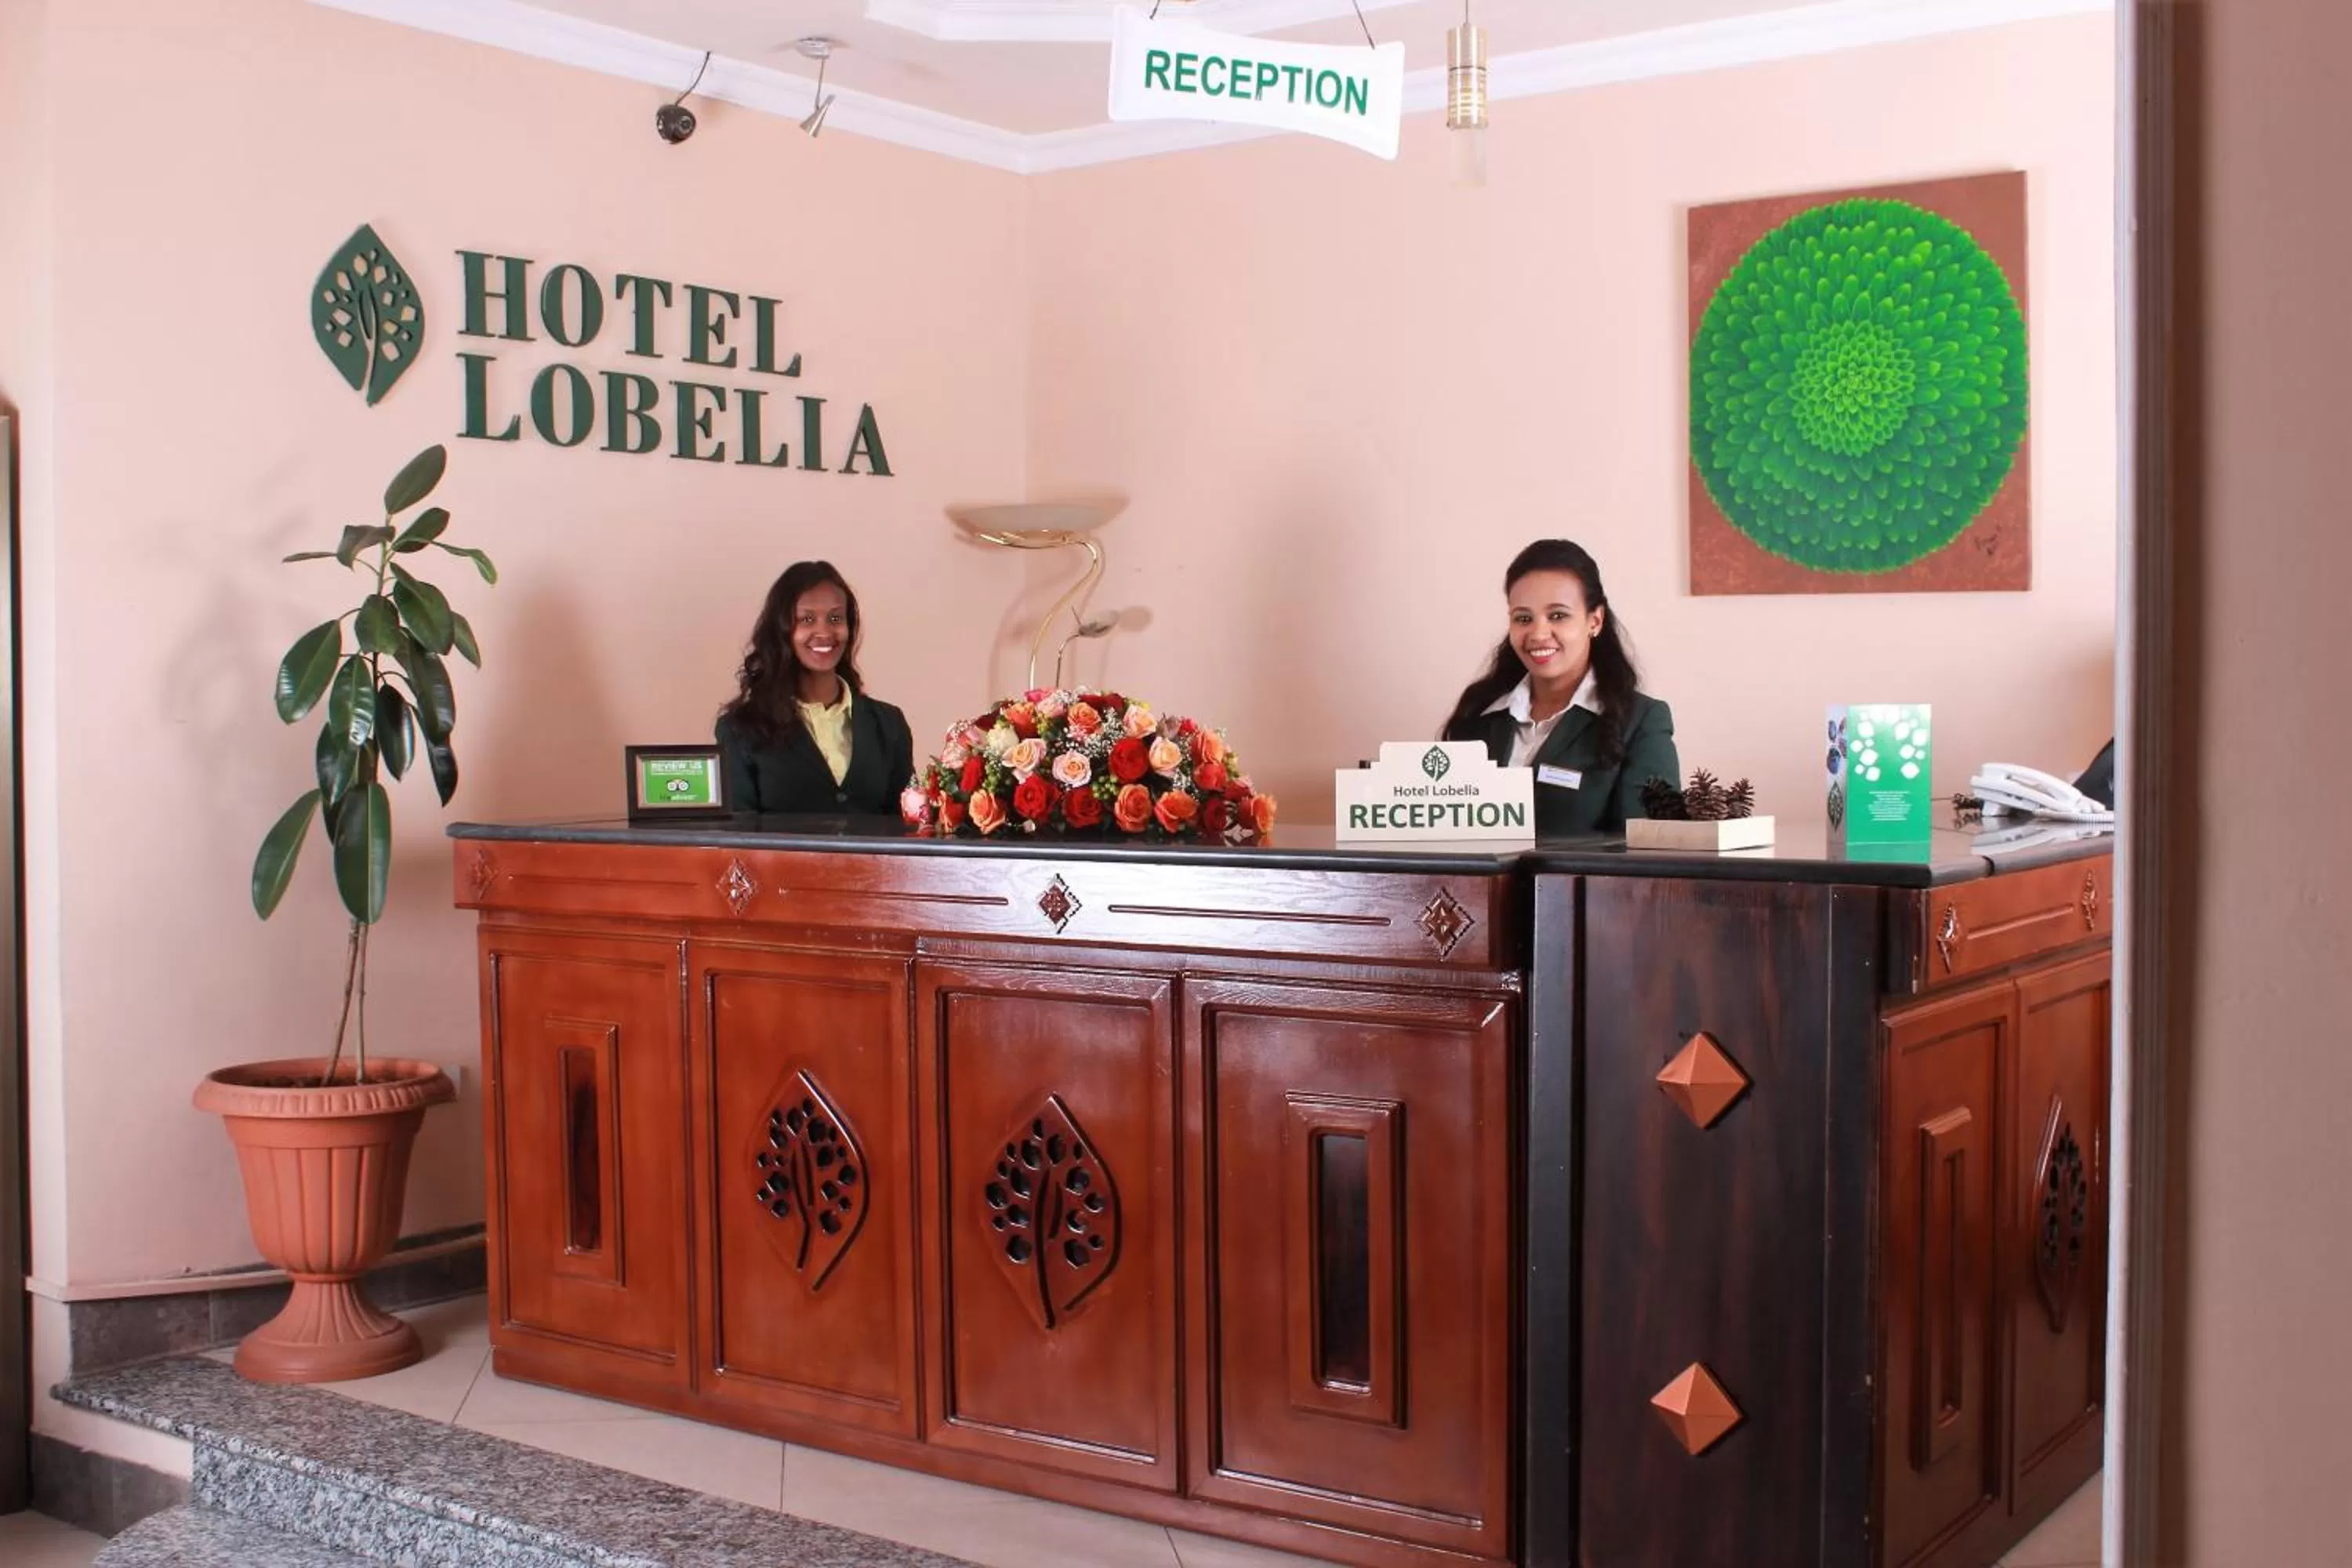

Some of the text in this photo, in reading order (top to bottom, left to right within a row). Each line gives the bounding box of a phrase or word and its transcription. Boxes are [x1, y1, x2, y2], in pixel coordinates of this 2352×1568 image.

[1144, 49, 1369, 116] RECEPTION
[455, 250, 802, 378] HOTEL
[456, 352, 895, 477] LOBELIA
[1349, 802, 1525, 829] RECEPTION
[1393, 784, 1480, 797] Hotel Lobelia
